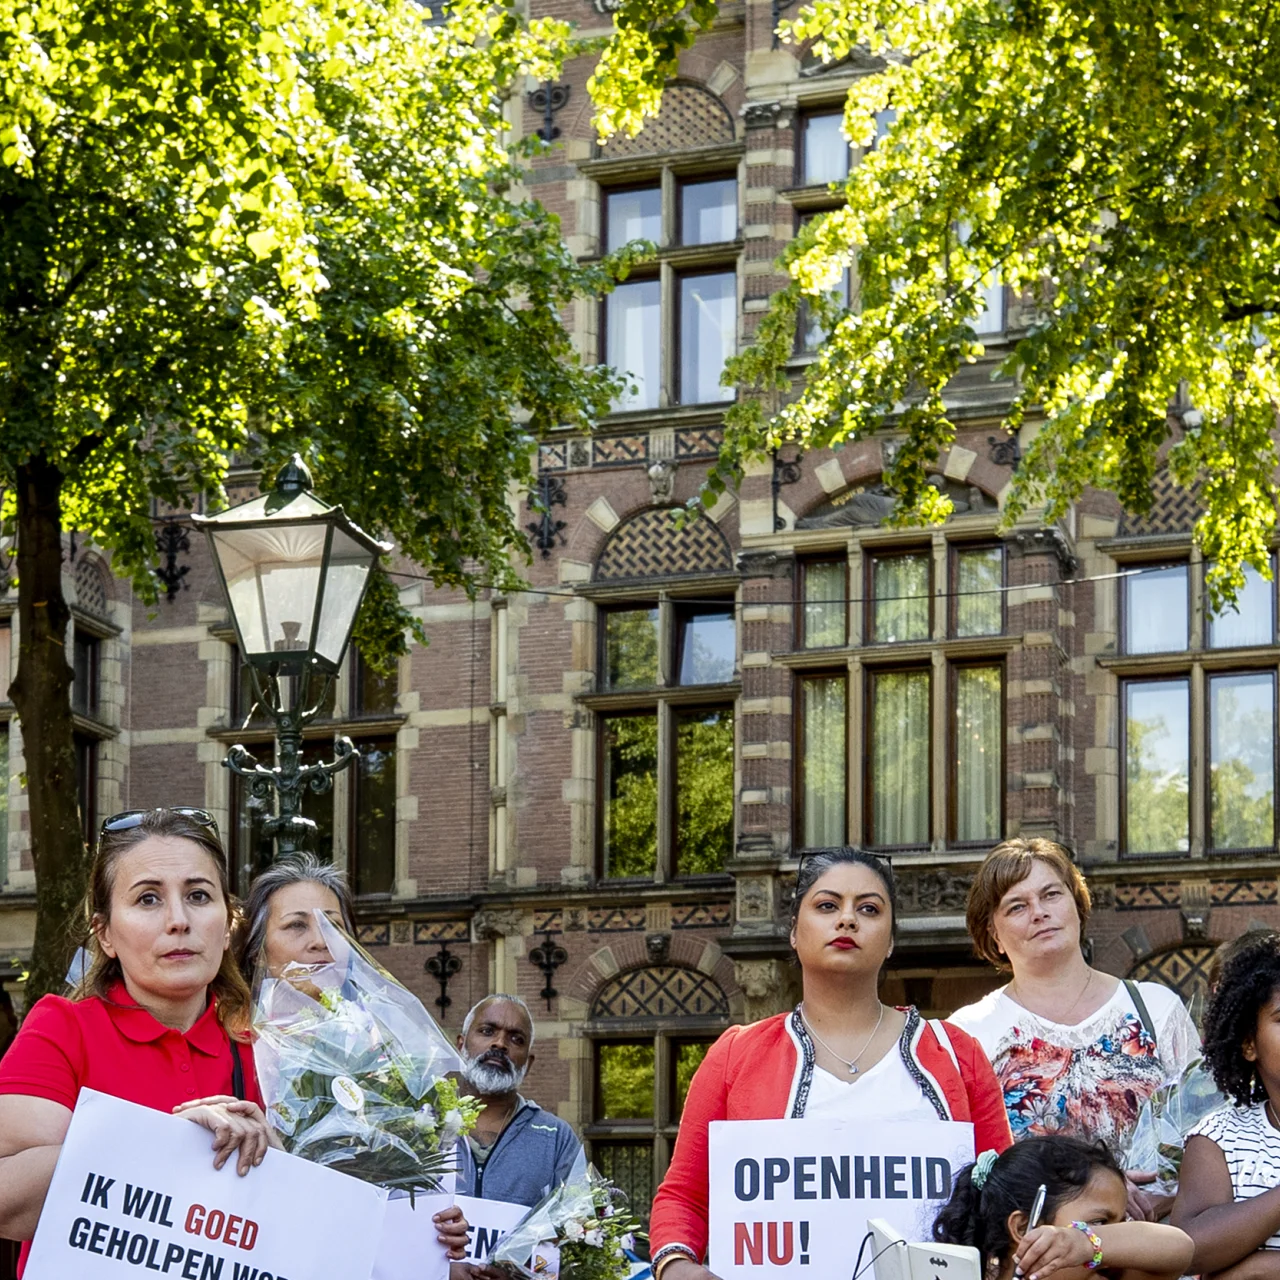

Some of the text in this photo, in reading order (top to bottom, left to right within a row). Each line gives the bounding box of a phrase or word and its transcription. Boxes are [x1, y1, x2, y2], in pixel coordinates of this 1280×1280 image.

[734, 1155, 953, 1202] OPENHEID
[80, 1172, 259, 1251] IK WIL GOED
[734, 1221, 810, 1265] NU!
